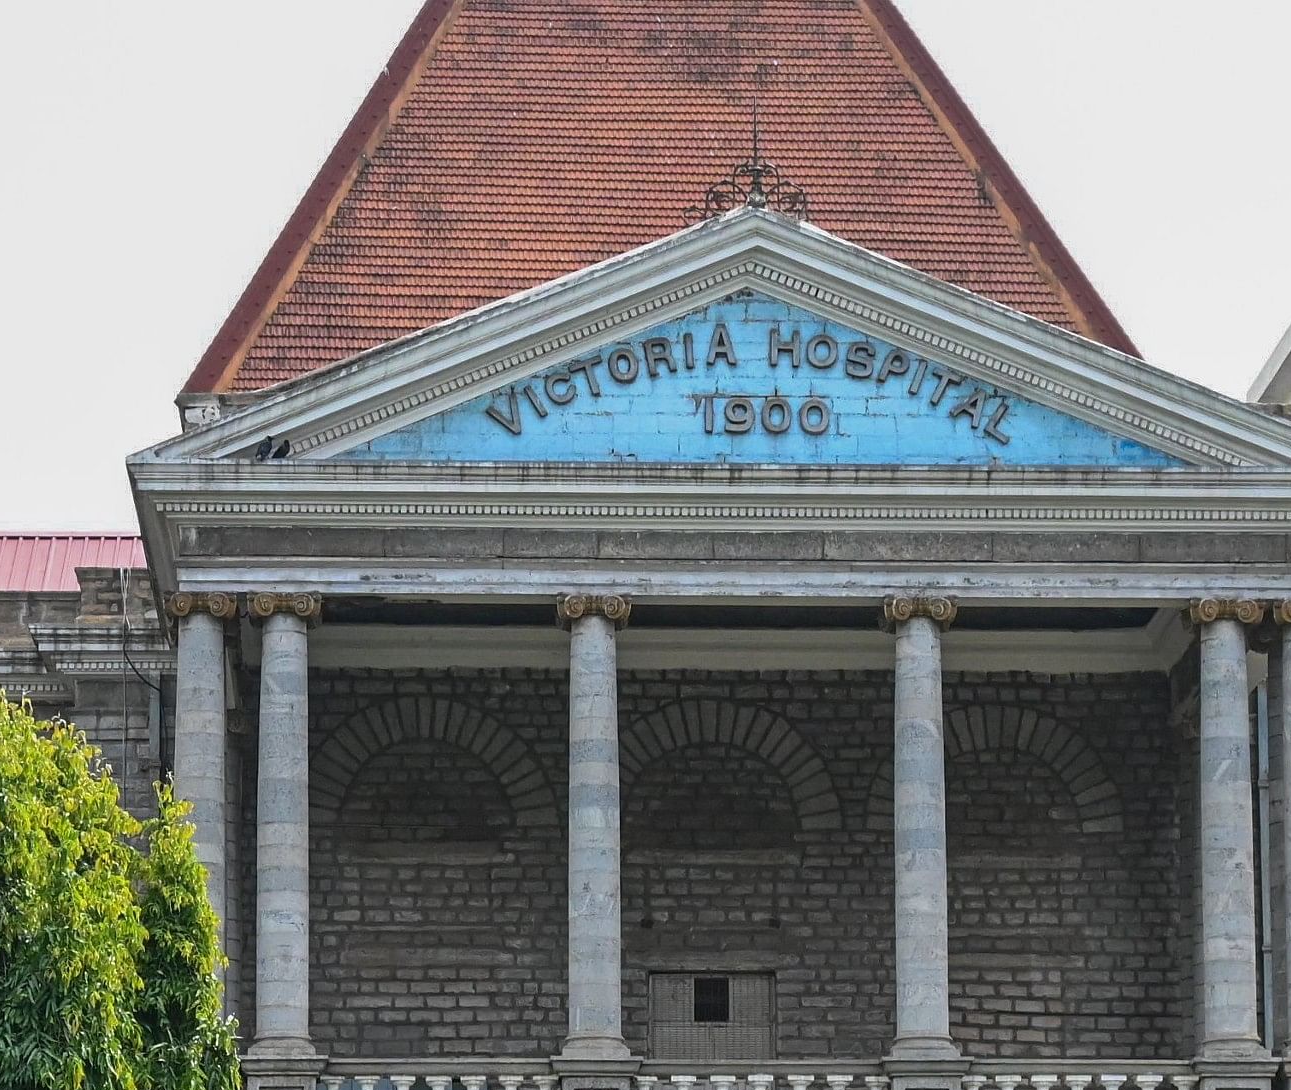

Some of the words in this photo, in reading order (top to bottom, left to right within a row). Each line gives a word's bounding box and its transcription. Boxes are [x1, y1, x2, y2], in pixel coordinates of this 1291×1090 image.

[485, 322, 738, 436] VICTORIA
[769, 327, 1010, 446] HOSPITAL
[693, 395, 830, 435] 1900
